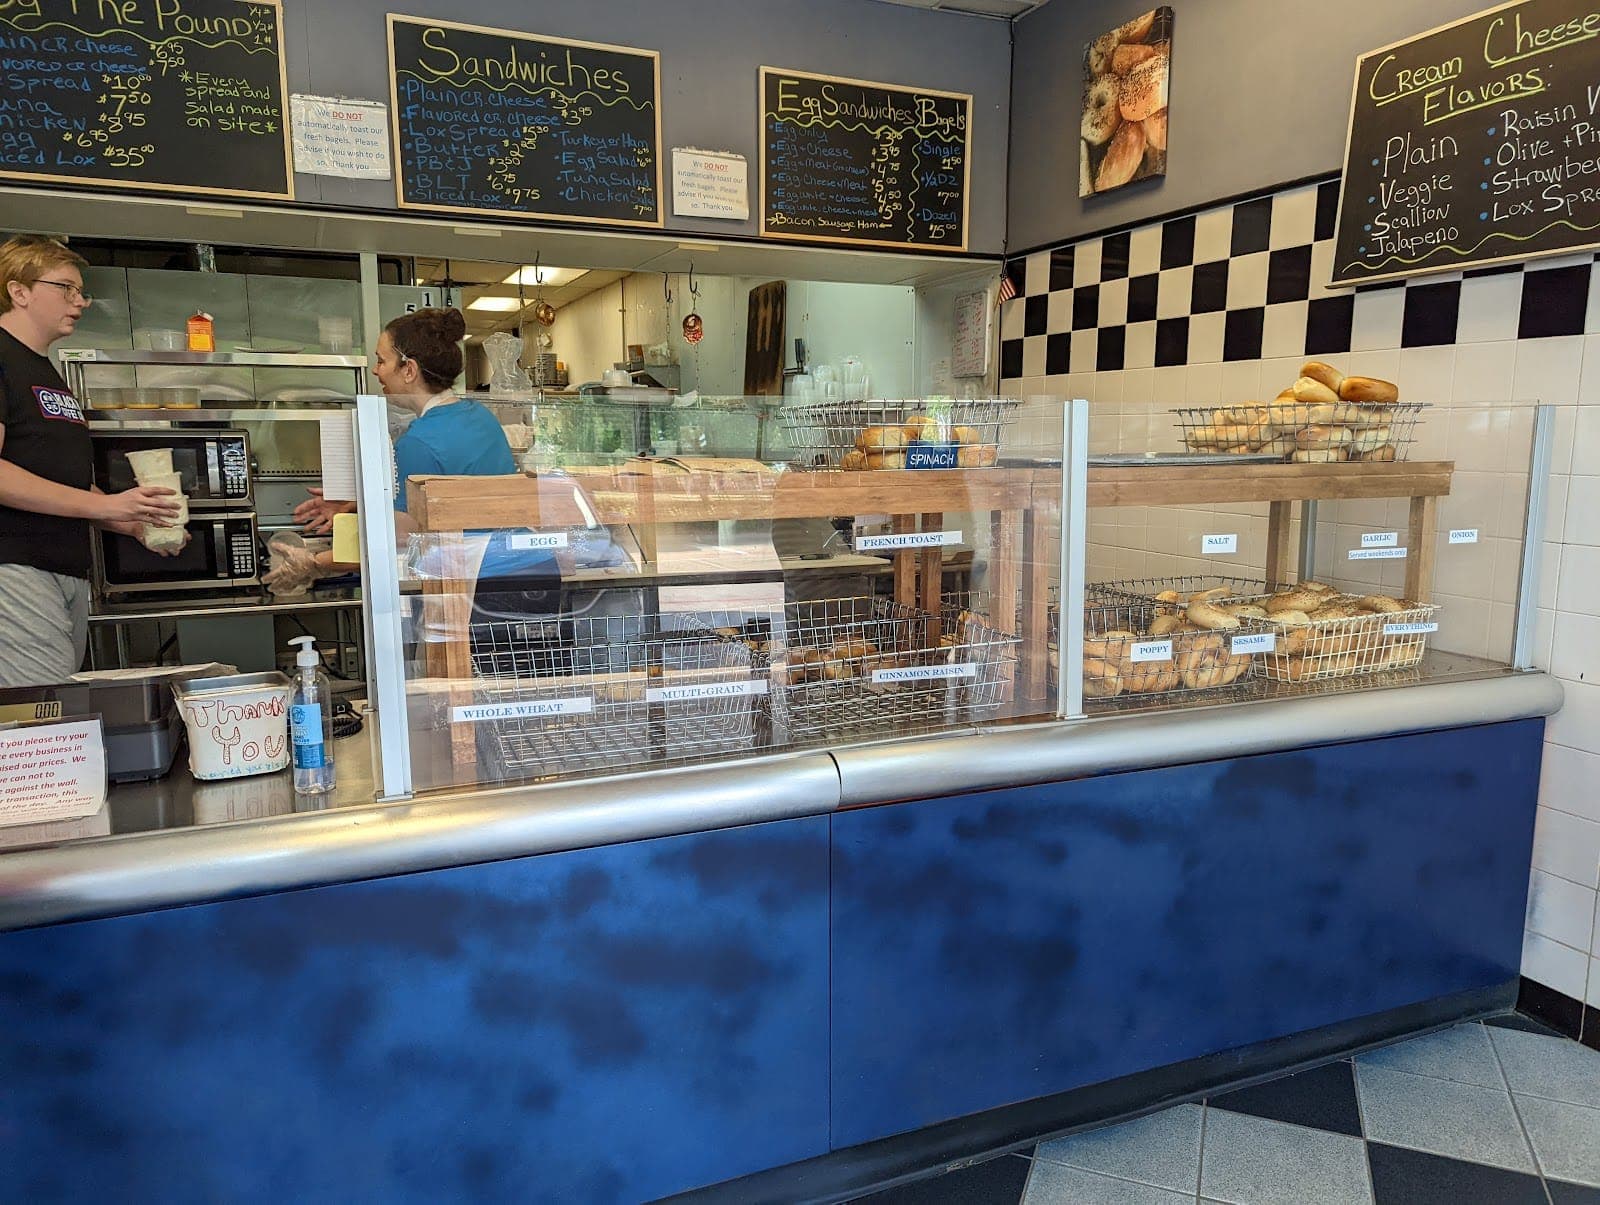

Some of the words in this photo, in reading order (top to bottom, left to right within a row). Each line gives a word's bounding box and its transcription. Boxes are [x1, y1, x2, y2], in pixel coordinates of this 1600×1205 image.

[418, 28, 630, 94] Sandwiches
[778, 79, 823, 121] Egg
[821, 85, 915, 125] Sandwiches
[331, 110, 345, 120] DO
[346, 112, 363, 121] NOT
[1500, 104, 1576, 137] Raisin
[350, 125, 369, 134] toast
[370, 127, 383, 135] our
[304, 132, 323, 141] fresh
[355, 138, 379, 147] Please
[347, 150, 364, 158] wish
[375, 152, 385, 160] do
[1384, 132, 1459, 177] Plain
[1496, 138, 1554, 166] Olive
[332, 160, 354, 169] Thank
[704, 162, 714, 170] DO
[715, 163, 728, 172] NOT
[1379, 173, 1453, 209] Veggie
[1493, 200, 1534, 222] Lox
[909, 453, 955, 465] SPINACH
[529, 536, 558, 547] EGG
[863, 537, 907, 548] FRENCH
[908, 534, 944, 545] TOAST
[1207, 536, 1230, 546] SALT
[1363, 533, 1392, 543] GARLIC
[1451, 531, 1475, 539] ONION
[1349, 550, 1368, 559] Served
[1385, 623, 1433, 632] EVERYTHING
[1233, 636, 1266, 646] SESAME
[1139, 645, 1169, 655] POPPY
[879, 669, 932, 680] CINNAMON
[932, 667, 965, 676] RAISIN
[660, 684, 745, 700] MULTI-GRAIN
[462, 706, 513, 720] WHOLE
[515, 703, 564, 715] WHEAT
[6, 740, 23, 749] you
[25, 736, 54, 747] please
[55, 734, 68, 743] try
[9, 750, 33, 760] every
[36, 746, 72, 756] business
[74, 743, 82, 752] in
[21, 762, 37, 770] our
[39, 757, 67, 770] prices.
[72, 754, 87, 763] We
[10, 775, 23, 783] can
[28, 772, 43, 780] not
[5, 784, 39, 795] against
[41, 781, 55, 789] the
